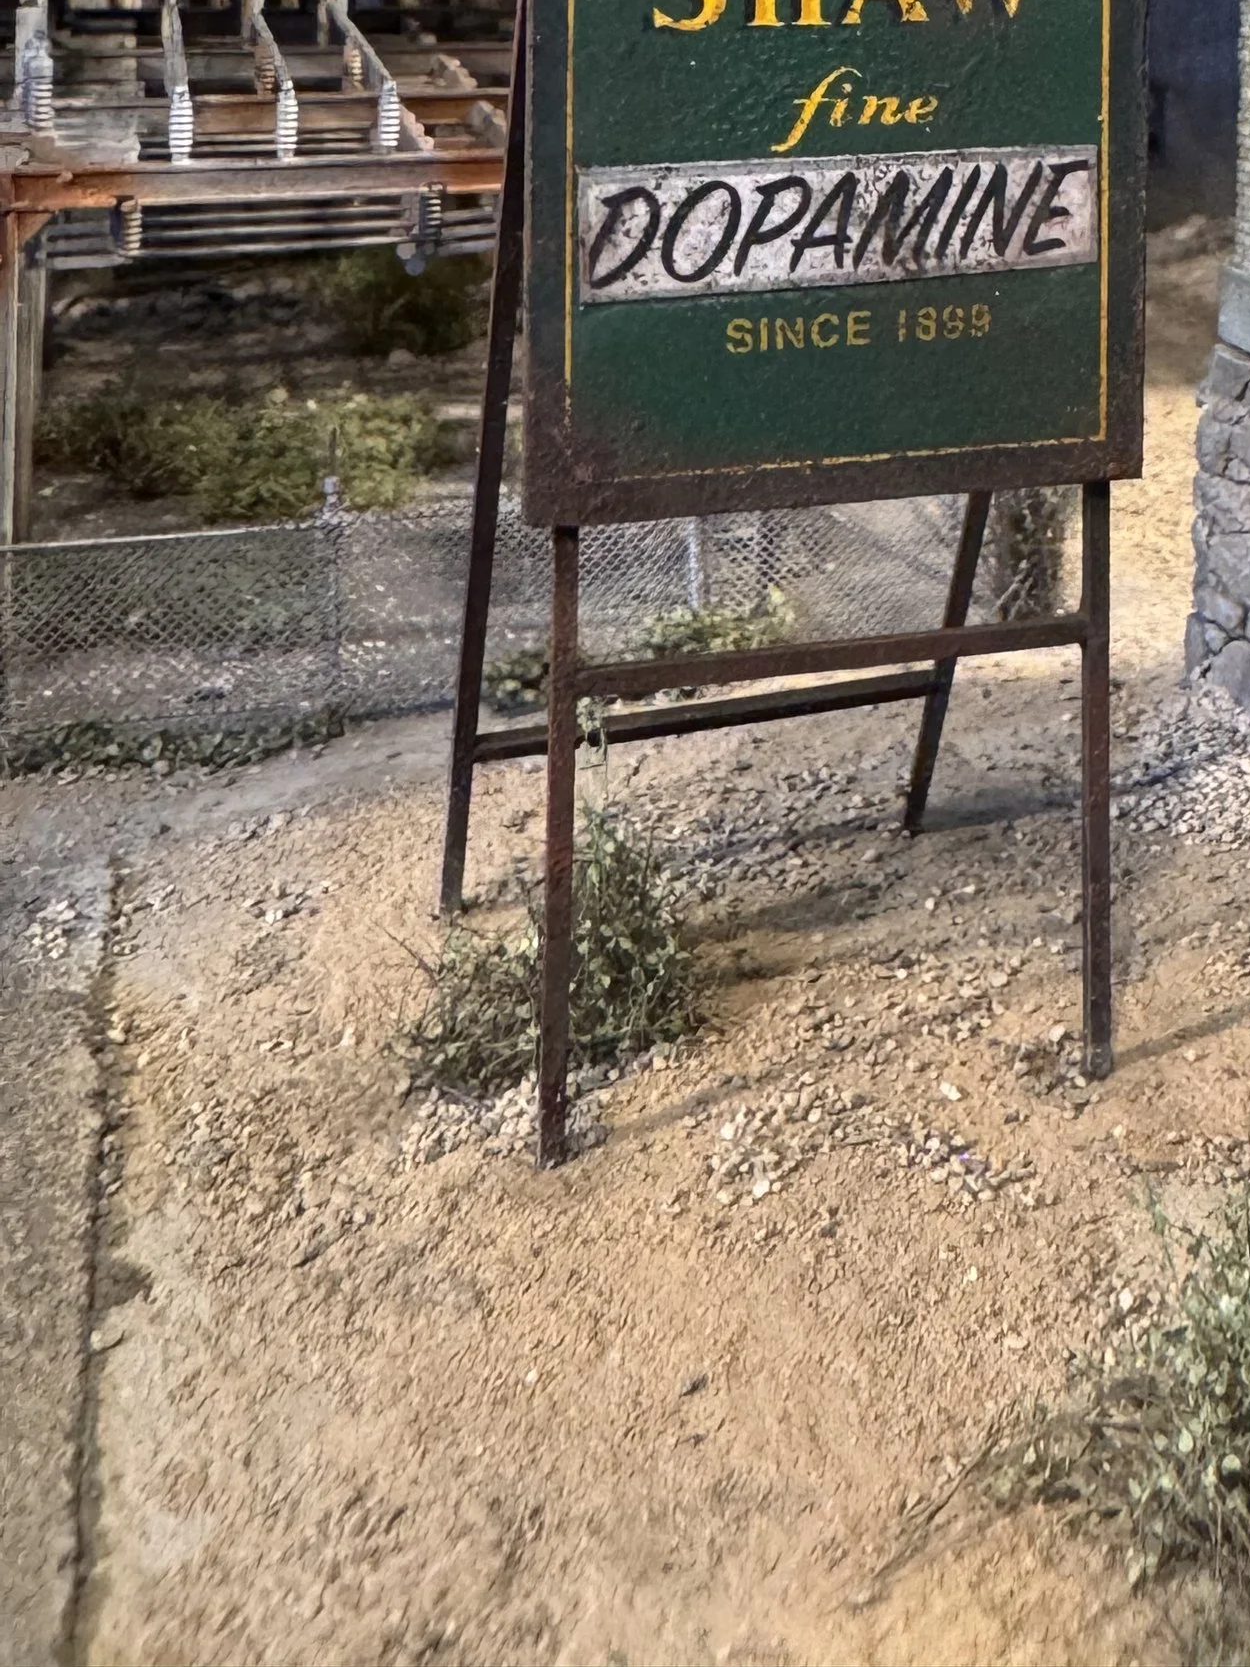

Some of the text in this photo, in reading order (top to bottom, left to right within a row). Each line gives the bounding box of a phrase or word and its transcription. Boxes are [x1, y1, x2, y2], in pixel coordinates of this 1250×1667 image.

[771, 67, 937, 153] fine
[588, 159, 1090, 289] DOPAMINE
[725, 310, 872, 354] SINCE
